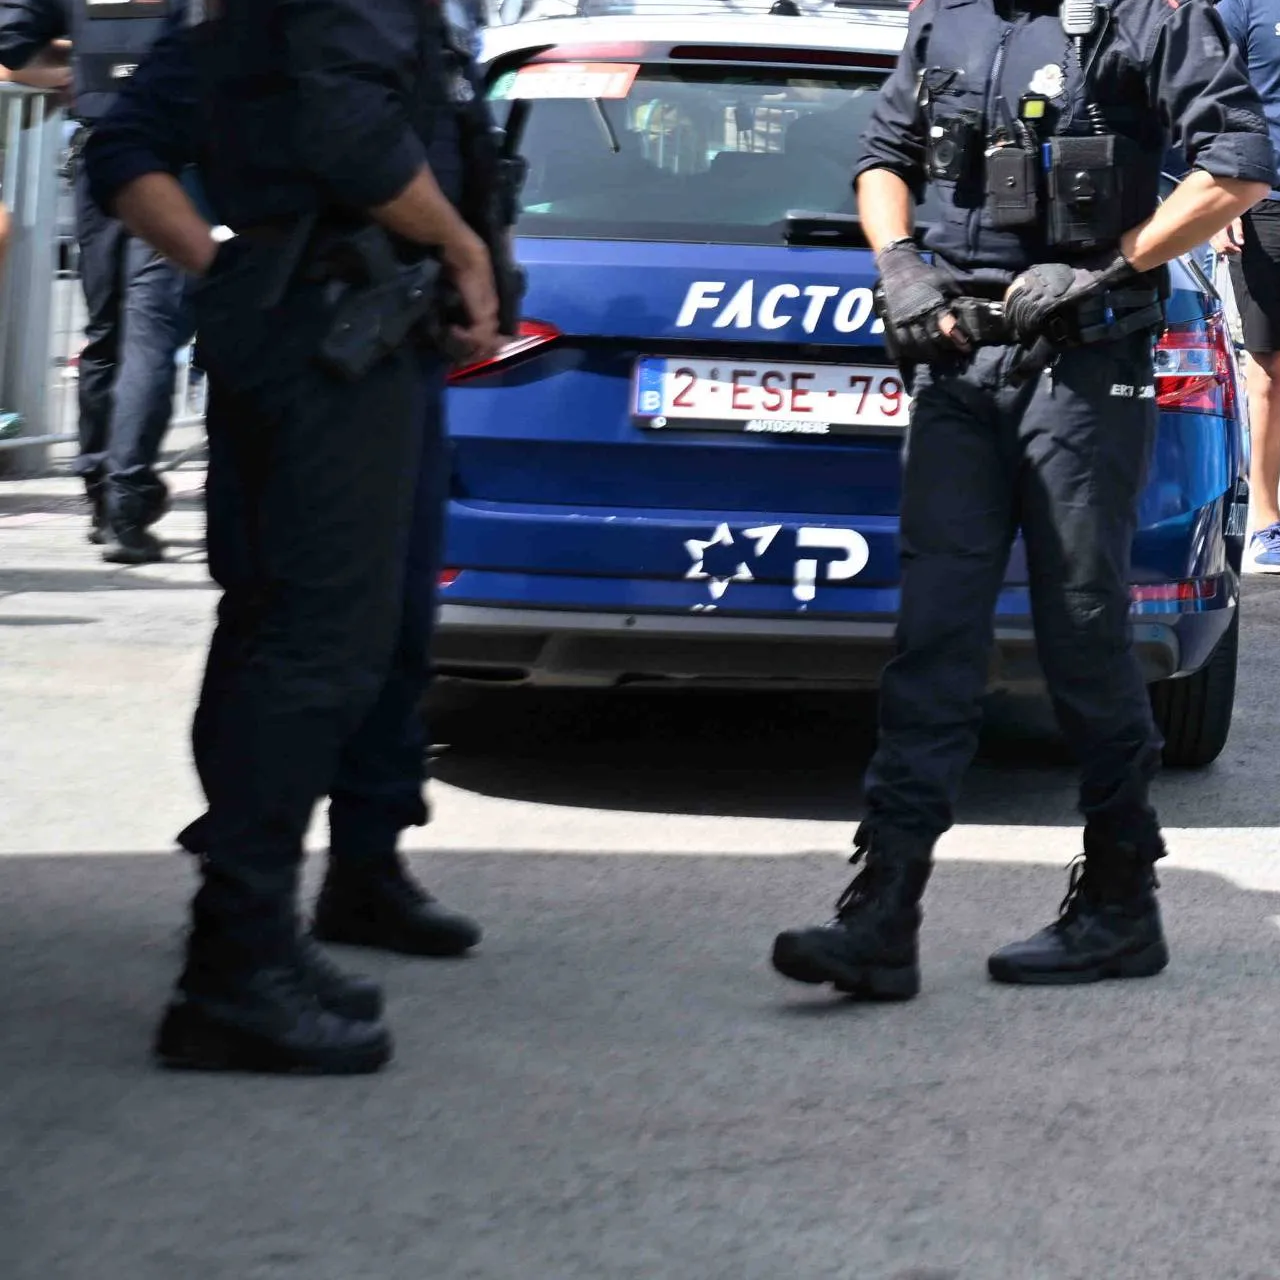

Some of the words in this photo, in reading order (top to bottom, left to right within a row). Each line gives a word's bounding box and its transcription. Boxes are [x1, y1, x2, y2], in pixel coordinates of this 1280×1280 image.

[675, 279, 886, 334] FACTO
[672, 366, 903, 417] 2-ESE-79
[744, 419, 830, 435] AUTOSPHERE
